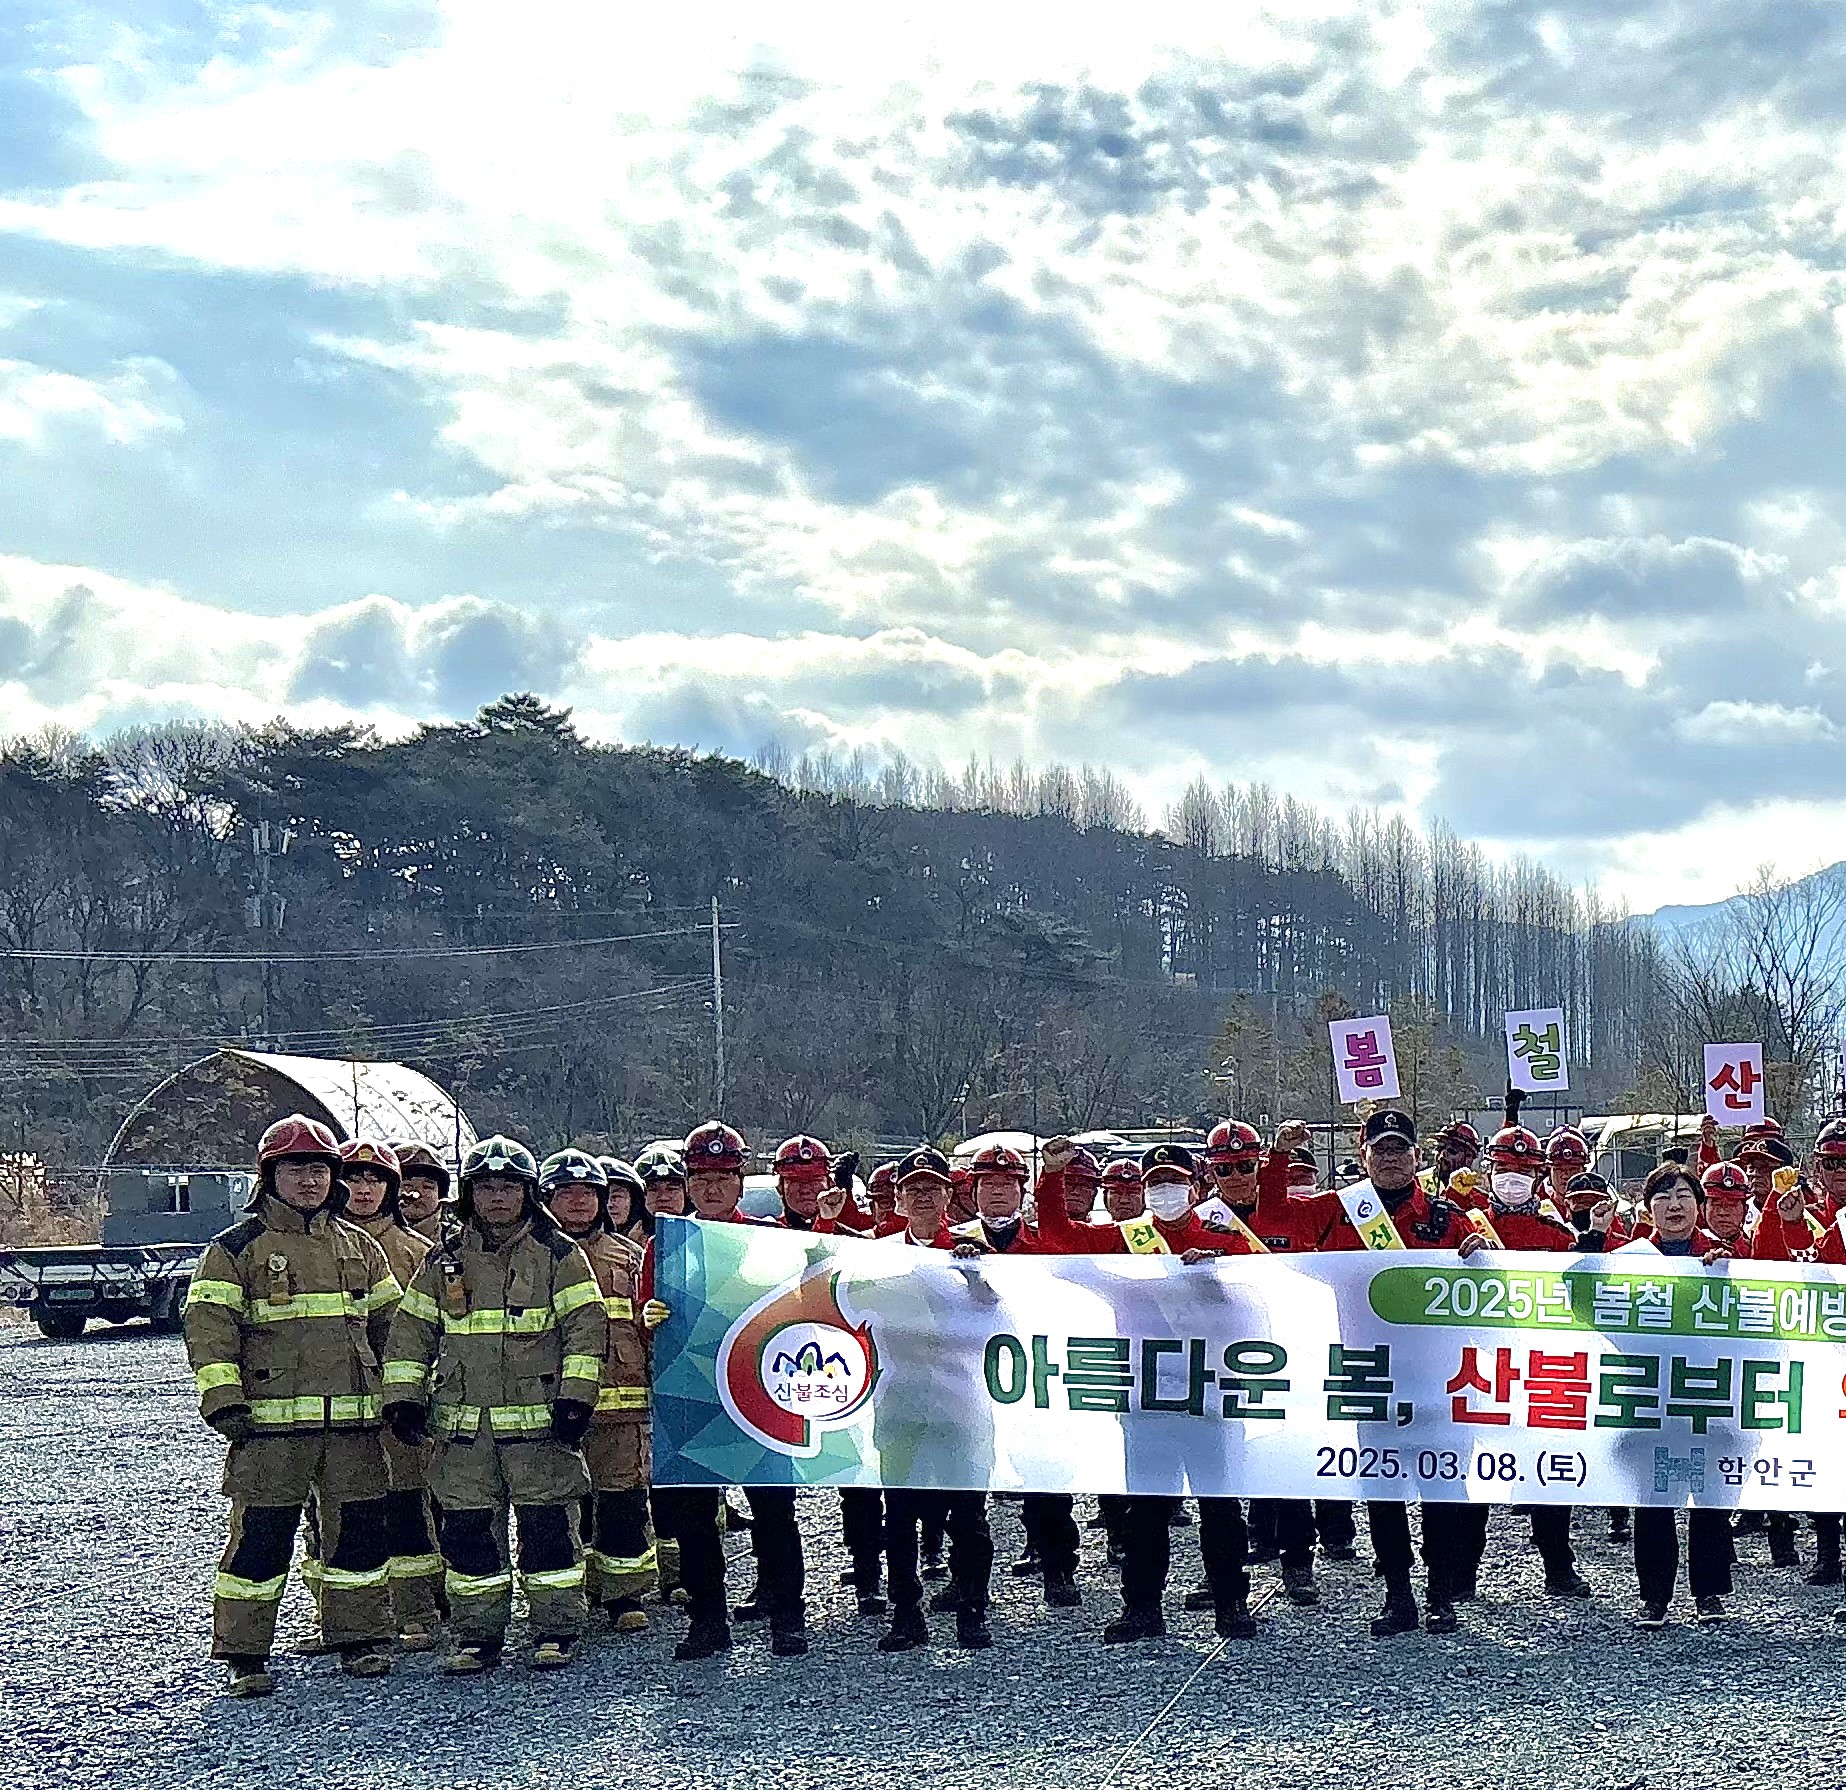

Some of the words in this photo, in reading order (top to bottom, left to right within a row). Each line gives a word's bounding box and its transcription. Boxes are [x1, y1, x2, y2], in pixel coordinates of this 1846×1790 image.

[1344, 1031, 1387, 1088] 봄
[1511, 1022, 1561, 1081] 철
[1708, 1060, 1762, 1110] 산
[1424, 1276, 1573, 1323] 2025년
[1592, 1280, 1674, 1329] 봄철
[773, 1382, 849, 1404] 산불조심
[984, 1334, 1291, 1420] 아름다운
[1323, 1343, 1414, 1427] 봄,
[1446, 1347, 1805, 1435] 산불로부터
[1315, 1446, 1409, 1480] 2025.
[1416, 1449, 1467, 1481] 03.
[1476, 1452, 1526, 1483] 08.
[1535, 1450, 1587, 1488] (토)
[1717, 1456, 1817, 1488] 함안군
